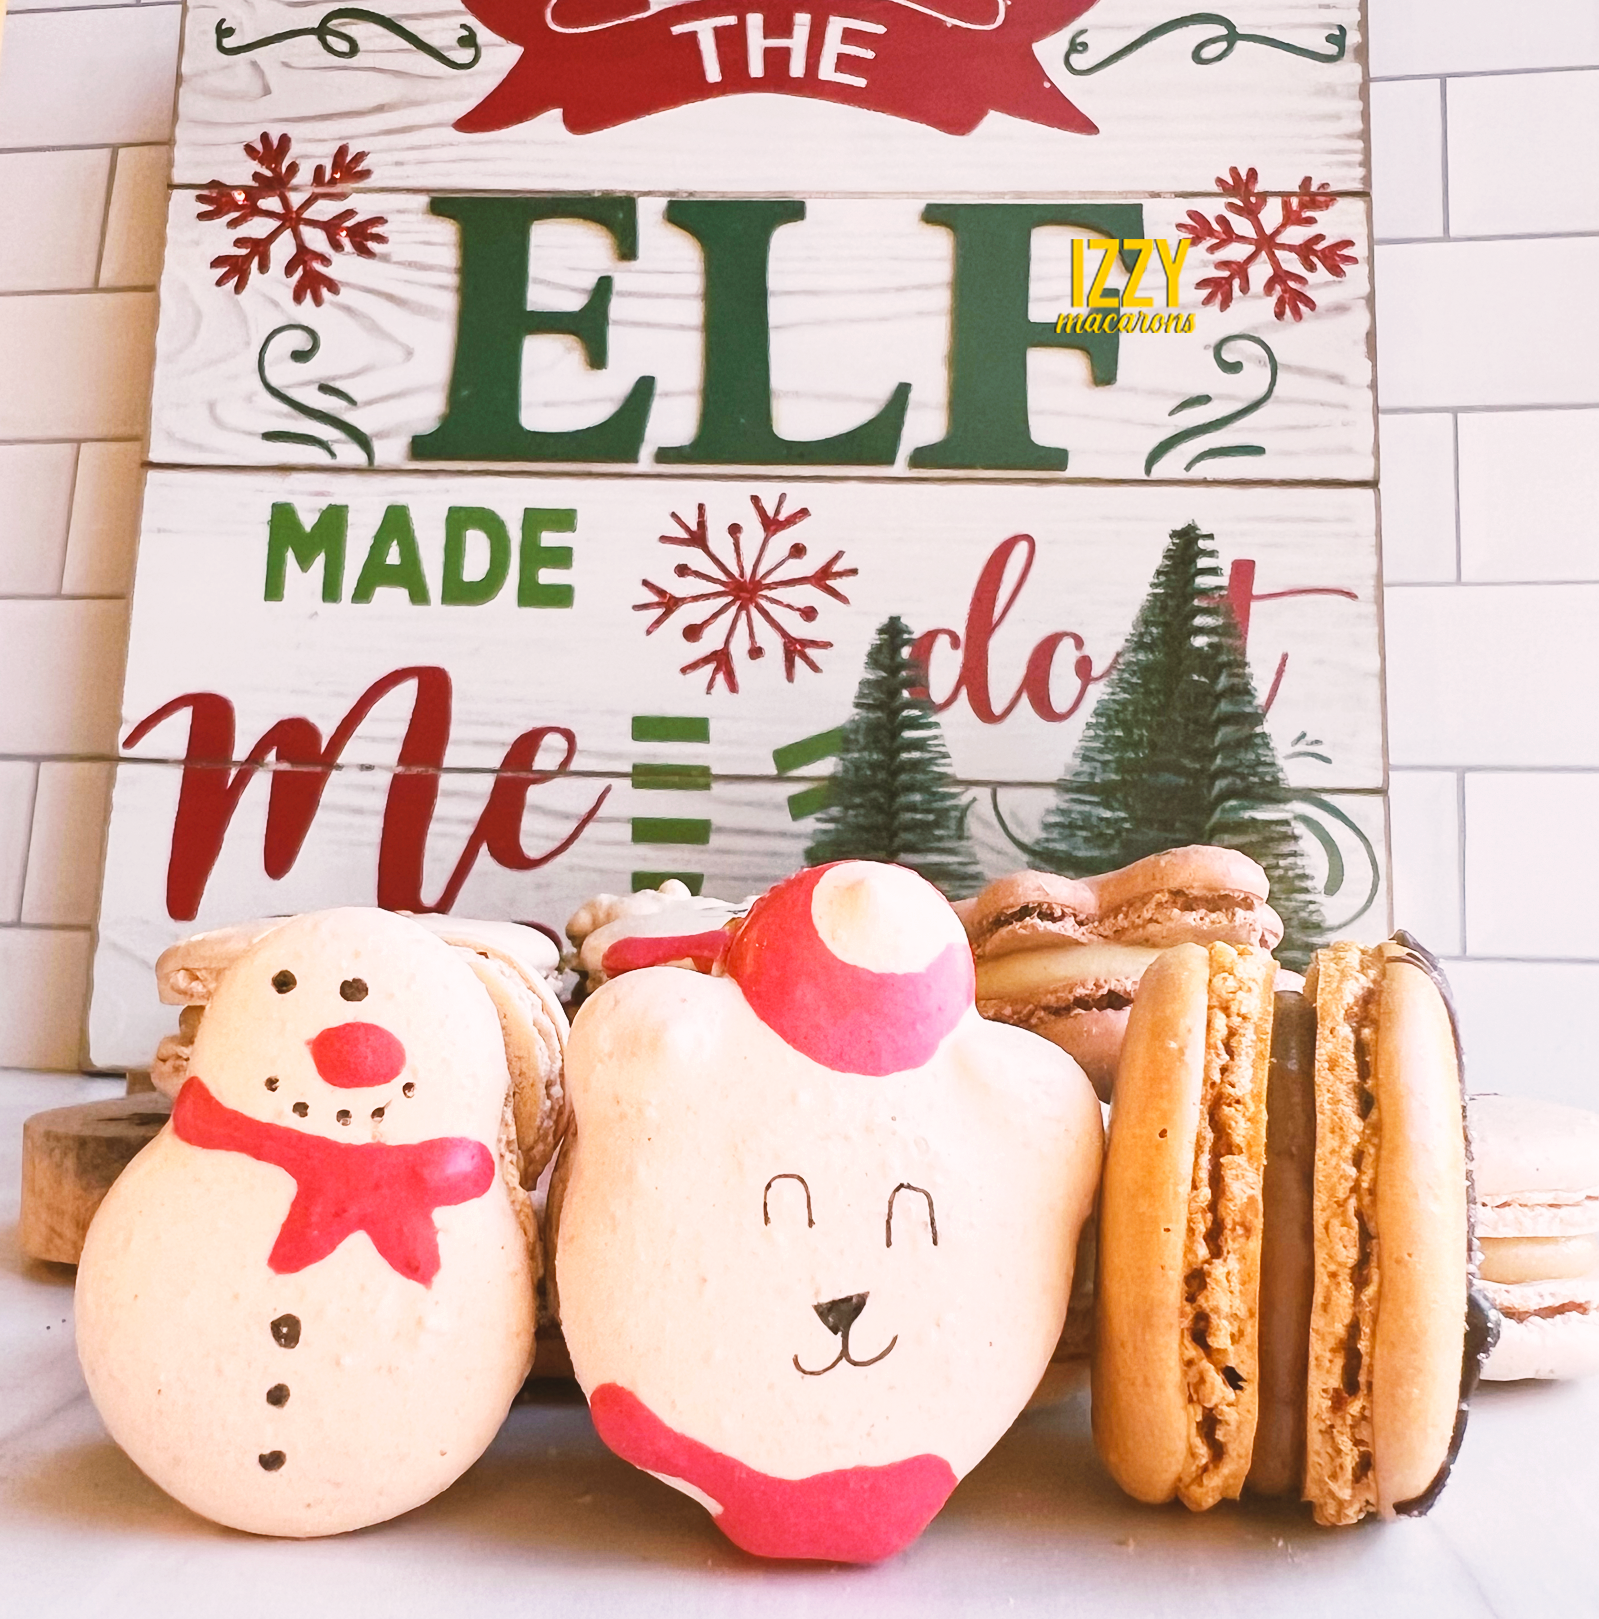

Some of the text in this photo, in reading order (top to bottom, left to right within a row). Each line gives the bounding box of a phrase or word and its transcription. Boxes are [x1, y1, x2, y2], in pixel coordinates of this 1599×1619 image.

[671, 13, 888, 88] THE
[410, 196, 1146, 470] ELF
[264, 501, 578, 609] MADE
[902, 534, 1098, 724] do
